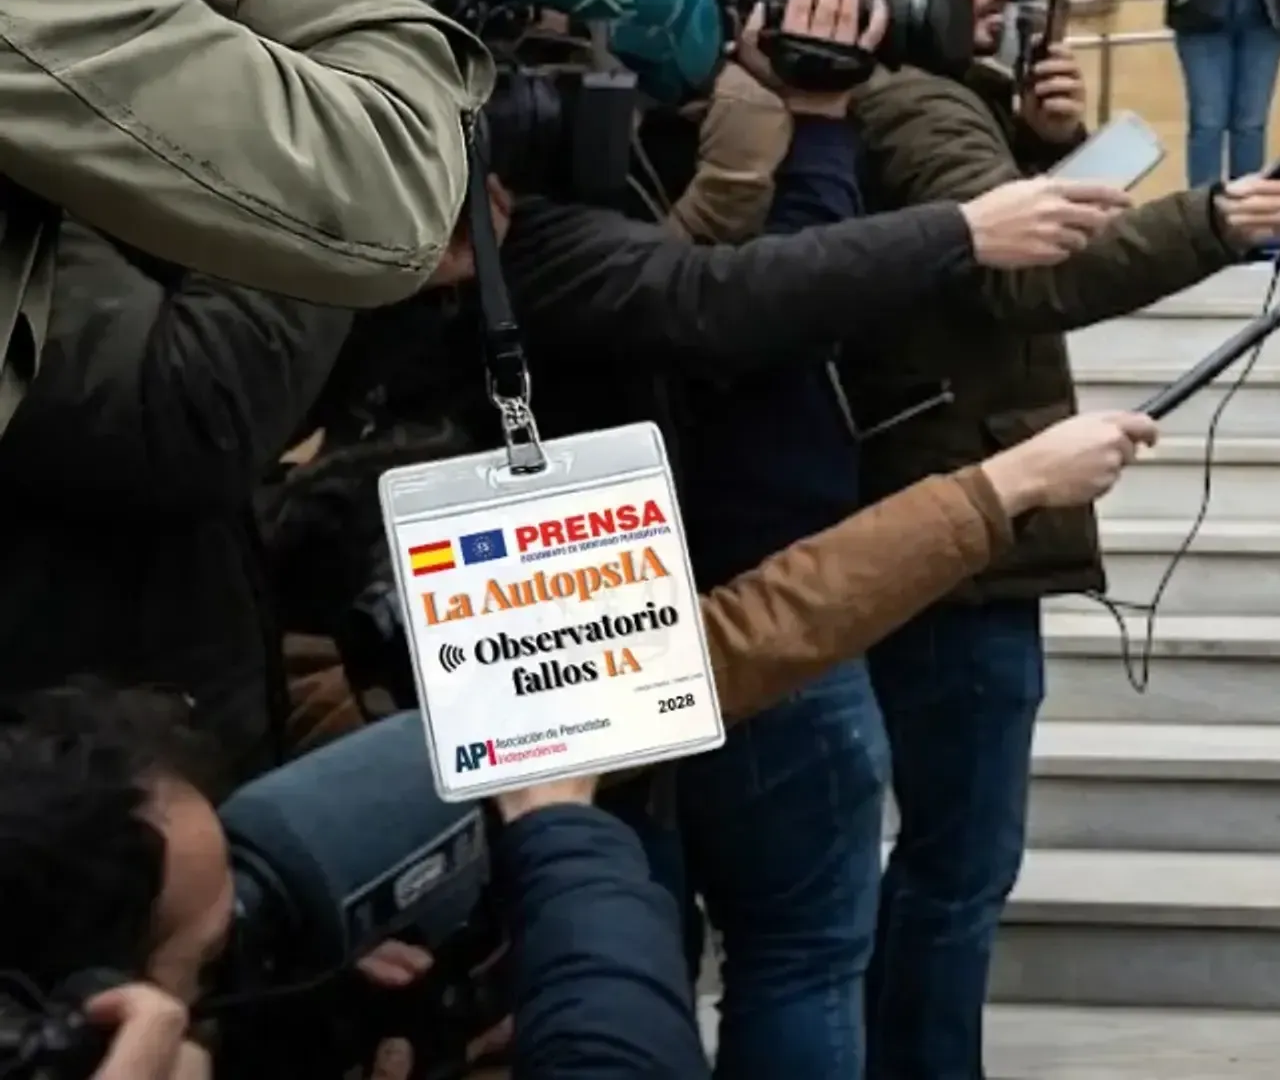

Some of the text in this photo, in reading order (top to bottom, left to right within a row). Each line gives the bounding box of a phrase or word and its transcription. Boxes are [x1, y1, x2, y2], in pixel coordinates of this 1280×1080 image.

[515, 499, 666, 553] PRENSA
[421, 546, 672, 626] La AutopsIA
[474, 601, 680, 665] Observatorio
[512, 658, 599, 696] fallos
[603, 646, 642, 678] IA
[657, 692, 696, 715] 2028
[455, 739, 497, 773] API
